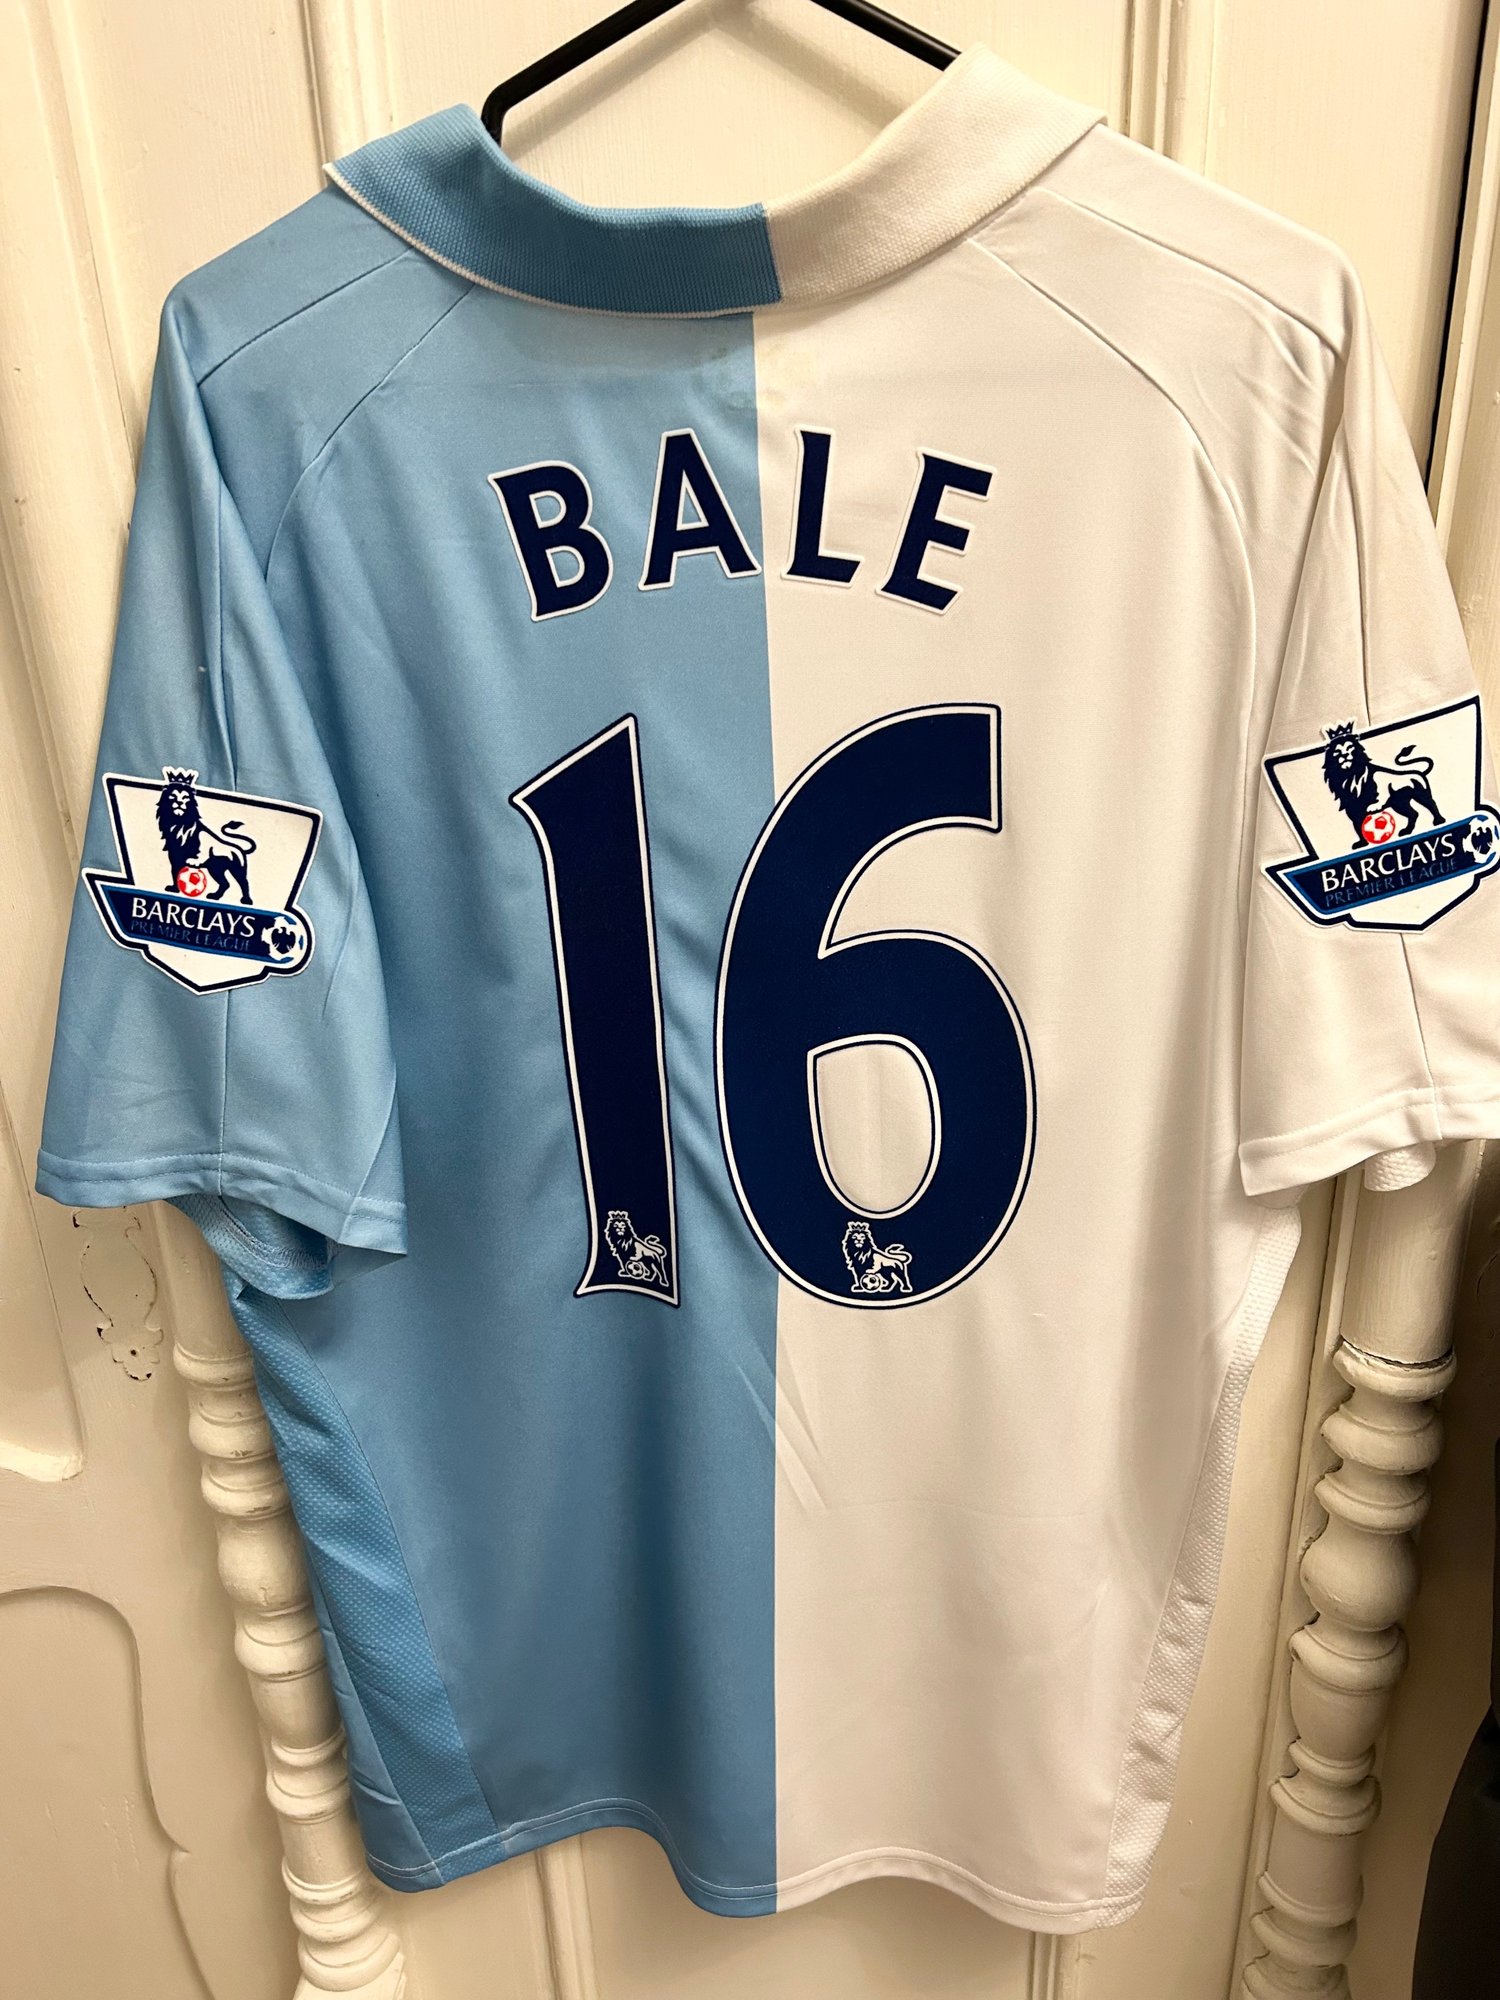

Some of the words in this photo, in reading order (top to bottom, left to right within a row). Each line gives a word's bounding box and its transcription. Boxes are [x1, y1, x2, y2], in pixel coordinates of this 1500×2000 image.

[488, 428, 996, 621] BALE
[1321, 833, 1456, 892] BARCLAYS
[1326, 877, 1395, 907] PREMIER
[1400, 858, 1456, 886] LEAGUE
[131, 920, 190, 940] PREMIER
[195, 931, 251, 951] LEAGUE
[132, 897, 256, 938] BARCLAYS
[509, 703, 1037, 1310] 16
